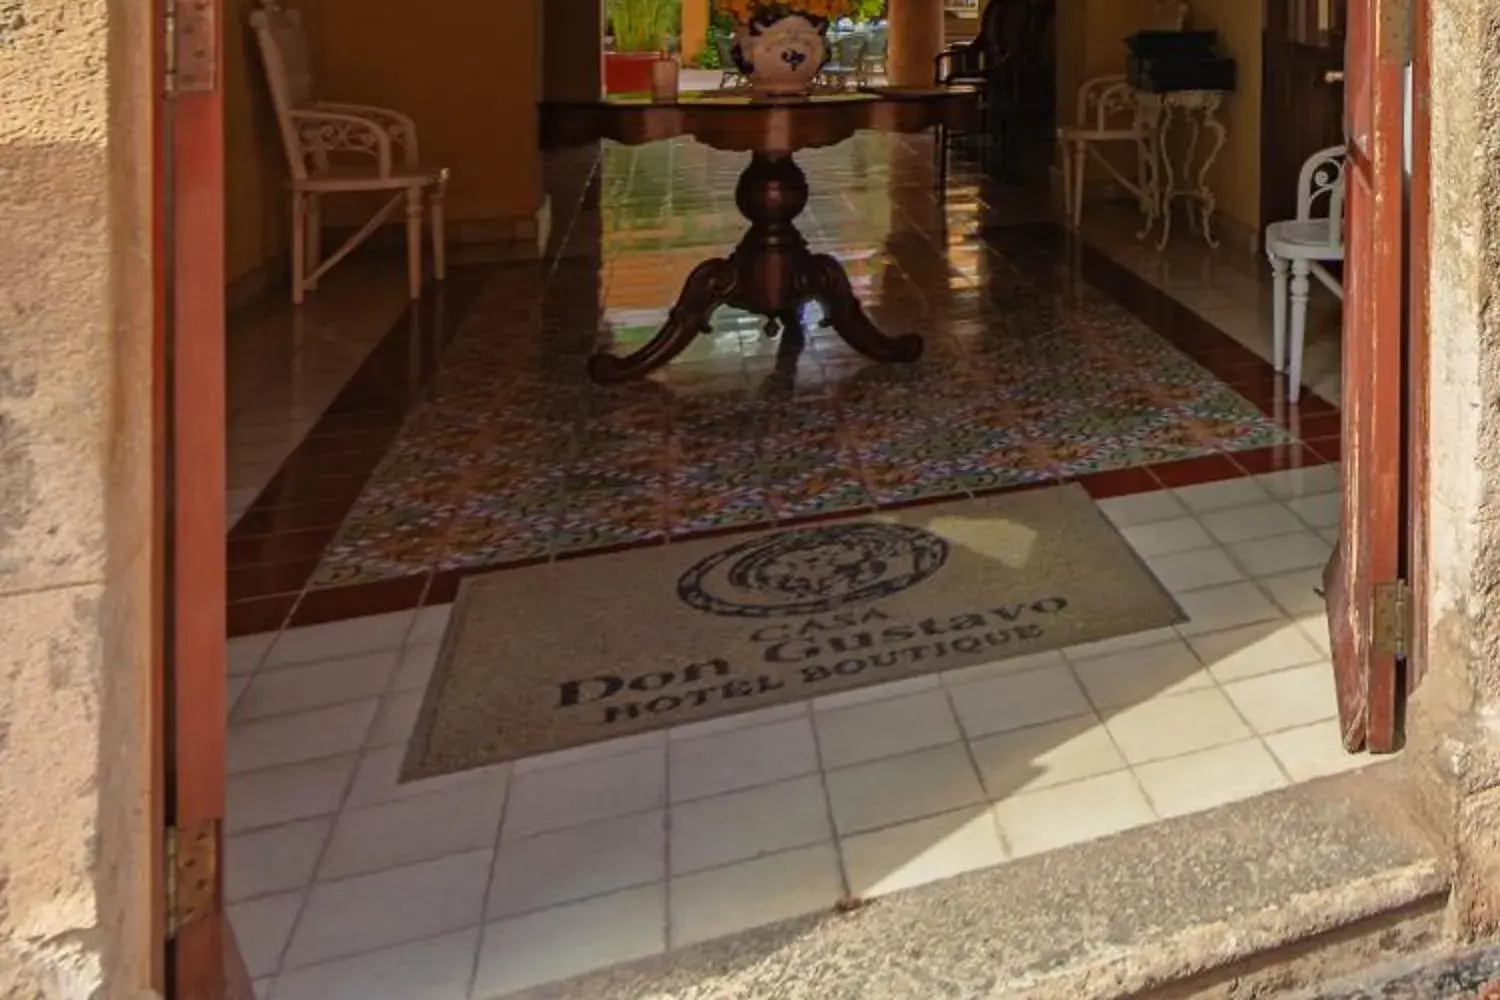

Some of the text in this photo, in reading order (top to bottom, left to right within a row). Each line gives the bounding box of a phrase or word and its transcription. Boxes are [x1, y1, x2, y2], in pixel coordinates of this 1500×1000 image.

[554, 597, 1069, 710] Don Gustavo
[603, 624, 1045, 724] HOTEL BOUTIQUE
[750, 608, 889, 644] CASA
